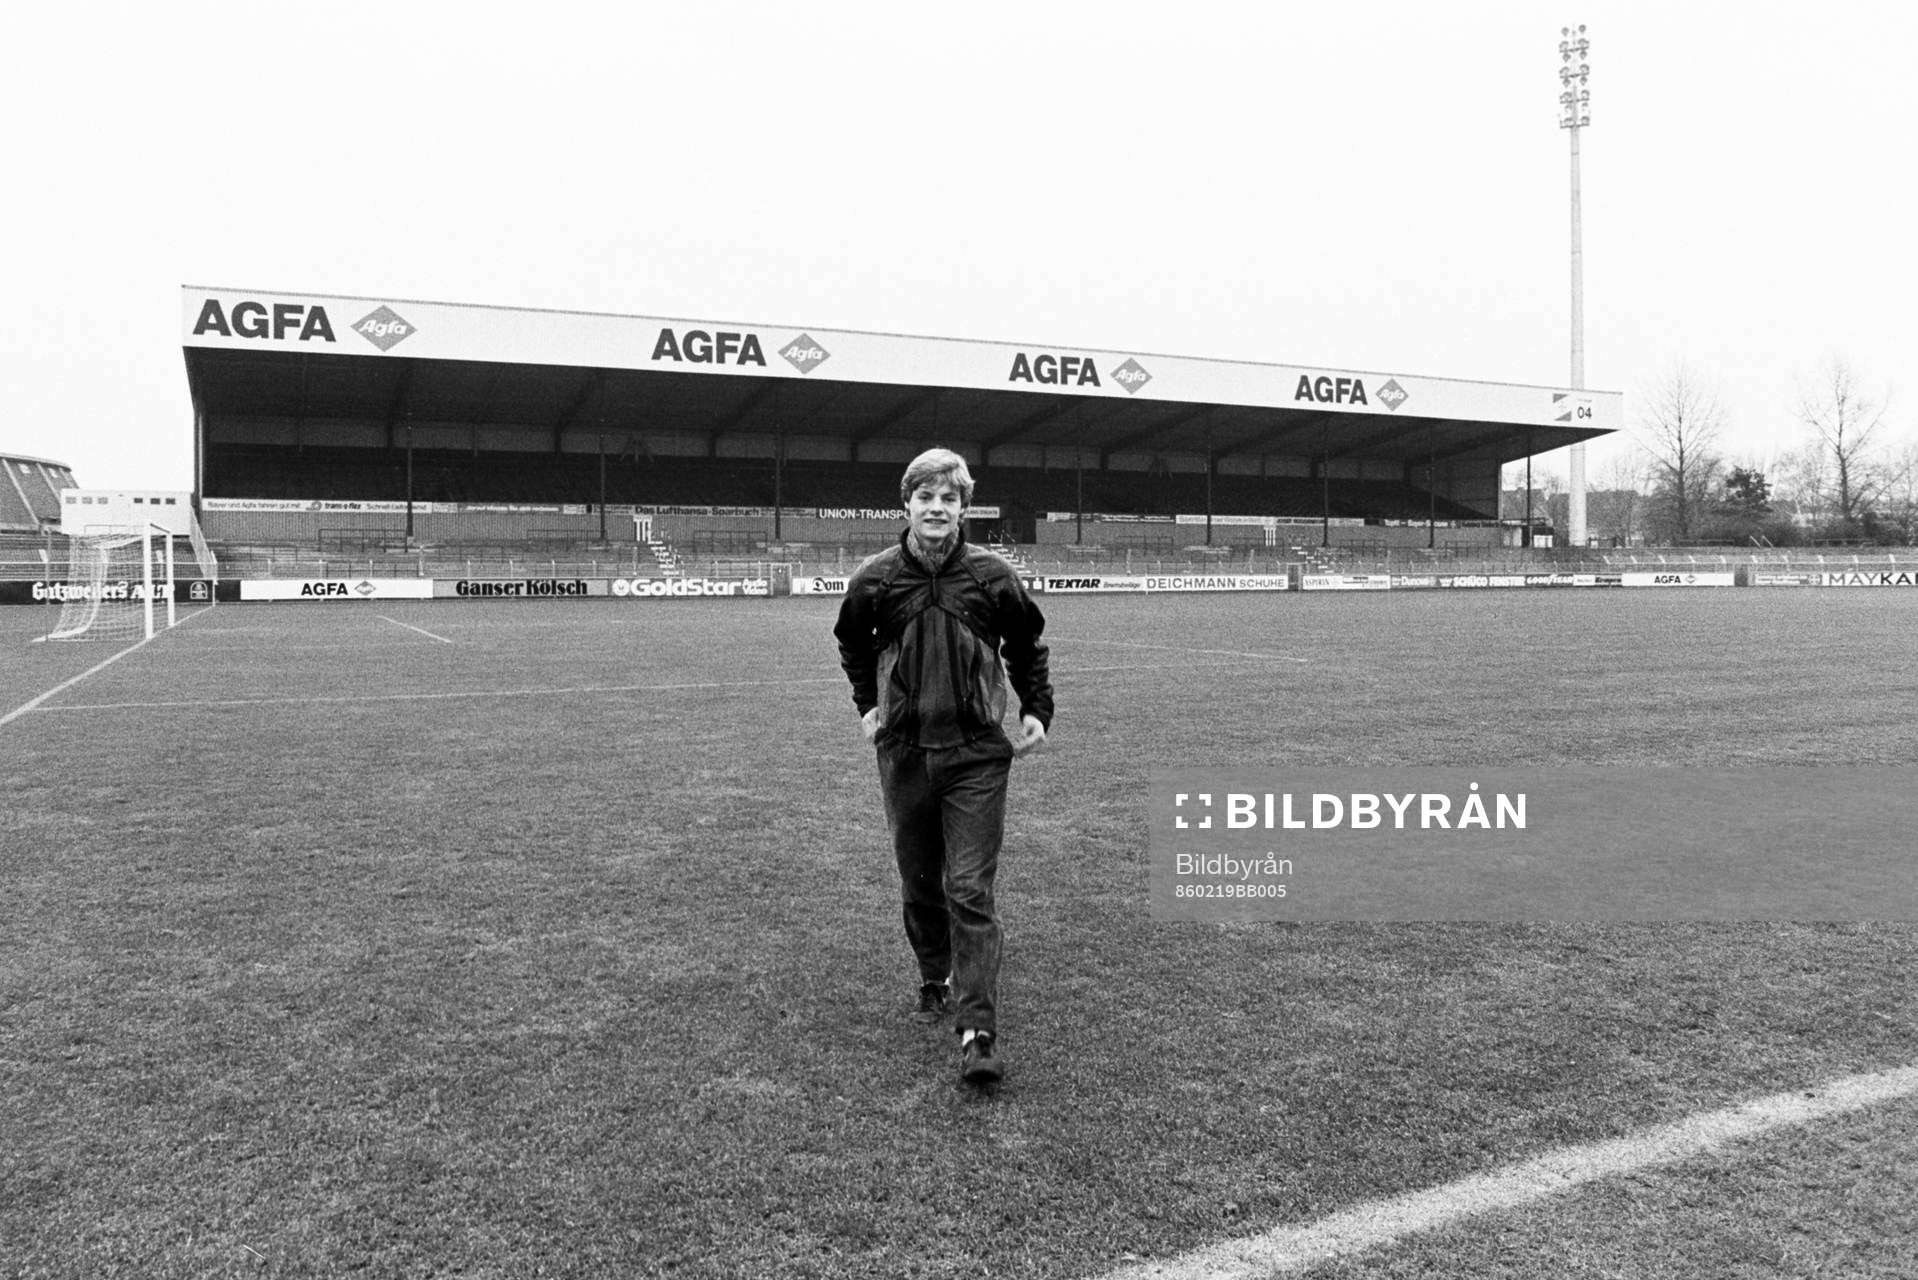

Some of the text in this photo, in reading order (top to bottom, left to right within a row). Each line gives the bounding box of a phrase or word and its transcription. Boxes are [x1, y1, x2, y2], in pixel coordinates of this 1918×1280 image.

[193, 299, 408, 343] AGFA Agfa
[651, 328, 824, 367] AGFA Agfa
[1008, 352, 1147, 388] AGFA Agfa
[1294, 375, 1405, 406] AGFA Agfa
[1577, 405, 1592, 419] 04
[634, 505, 654, 515] Das
[456, 578, 588, 596] Ganser Kölsch
[630, 578, 742, 596] GoldStar
[812, 577, 844, 592] Dom
[1048, 579, 1100, 589] TEXTAR
[1147, 578, 1285, 589] DEICHMANN SCHUHE
[1654, 575, 1681, 584] AGFA
[301, 582, 348, 596] AGFA
